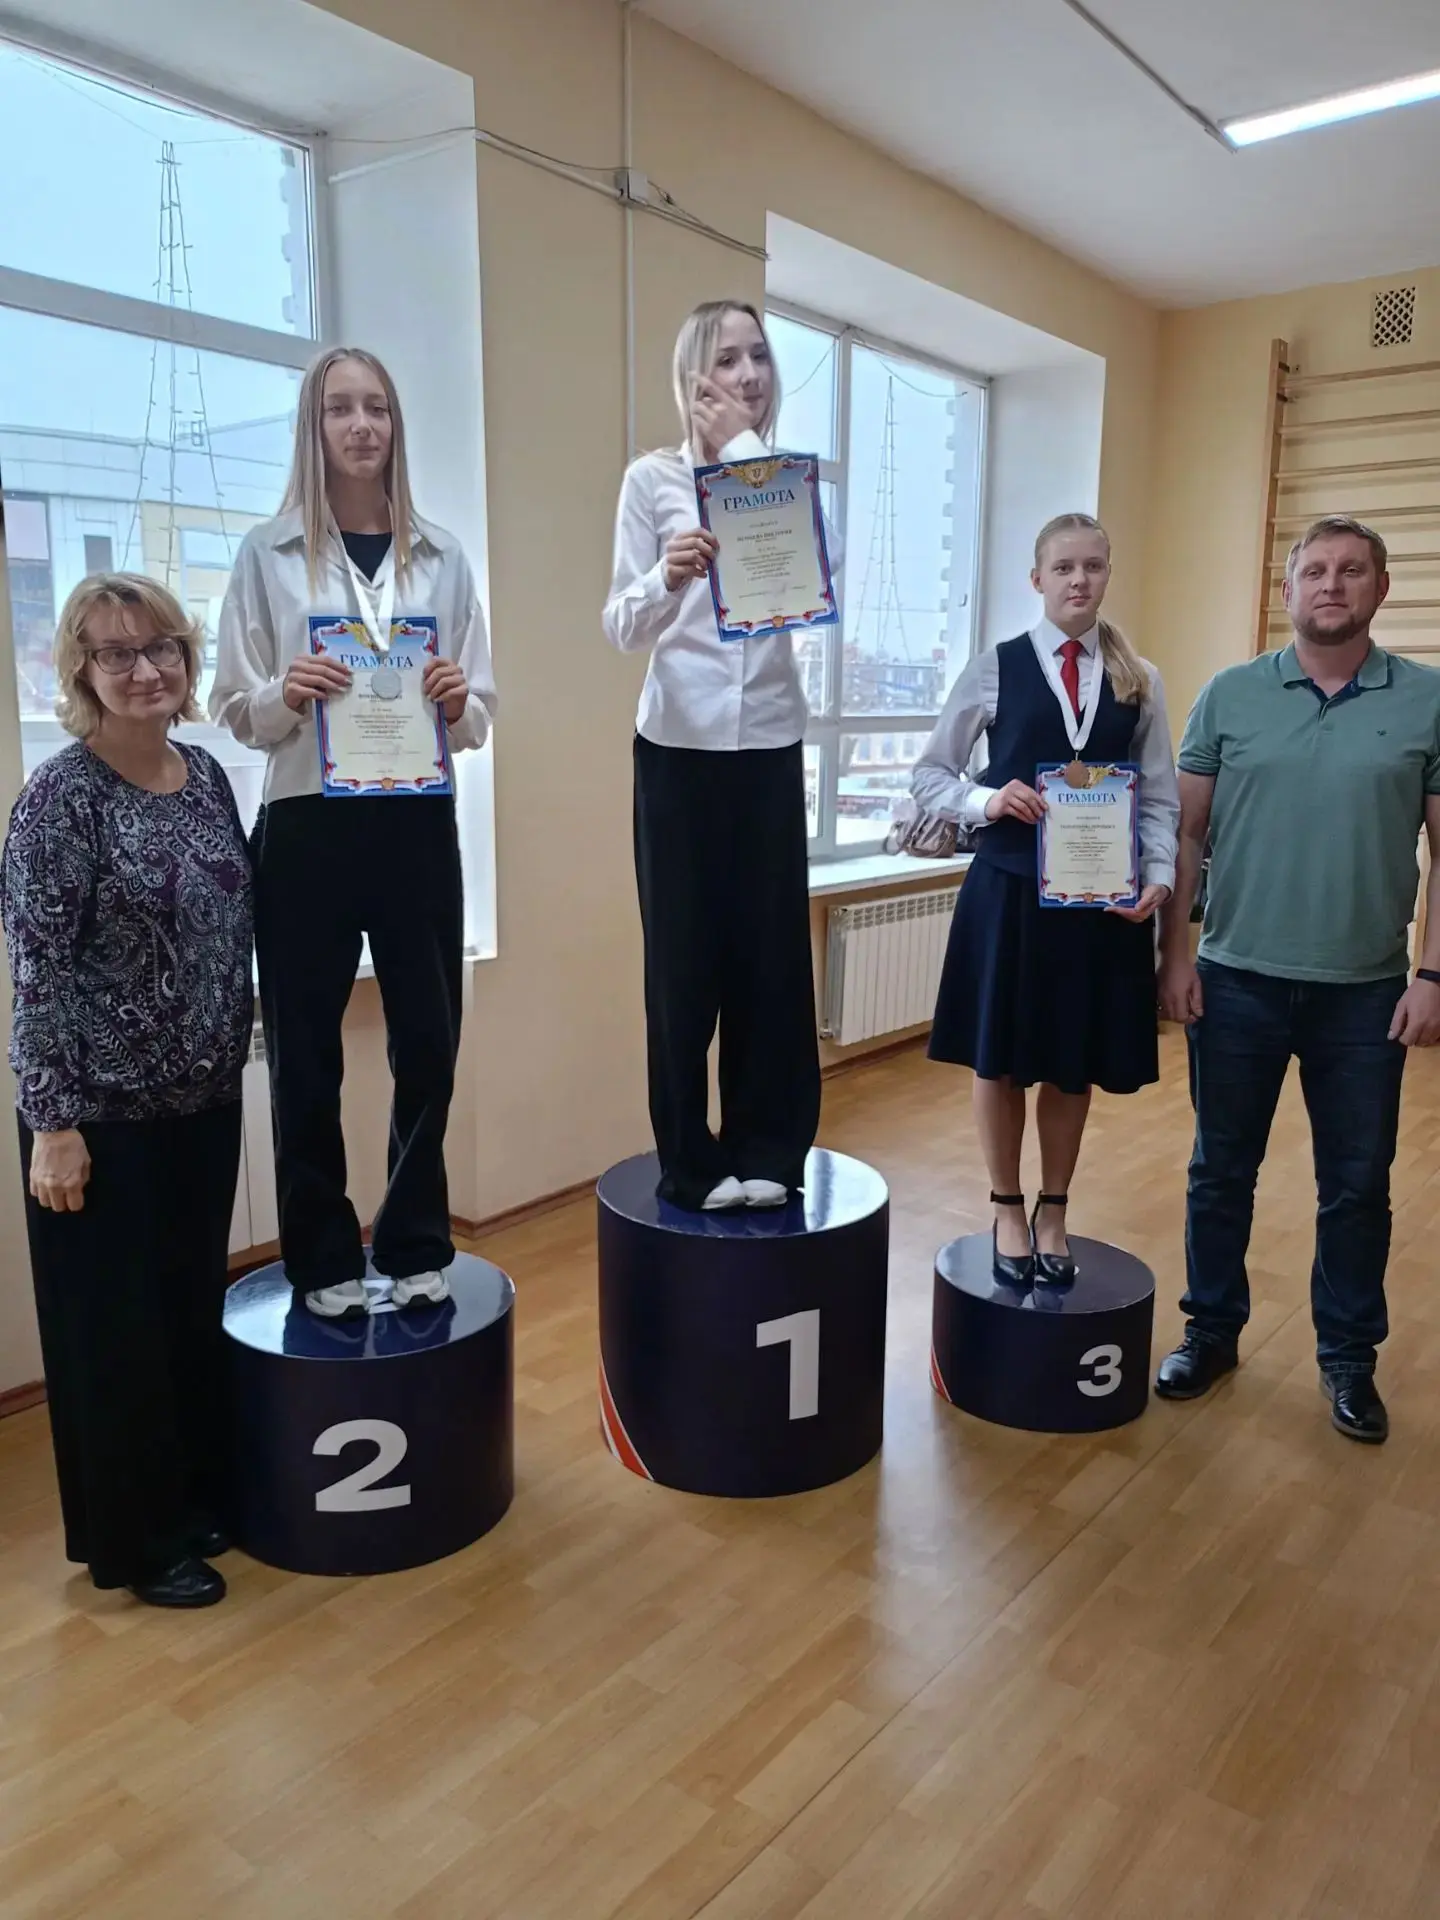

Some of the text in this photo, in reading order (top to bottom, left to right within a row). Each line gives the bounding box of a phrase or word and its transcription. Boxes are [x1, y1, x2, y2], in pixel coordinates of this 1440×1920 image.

[723, 489, 796, 511] ГРАМОТА
[340, 654, 413, 668] ГРАМОТА
[1058, 792, 1117, 803] ГРАМОТА
[756, 1309, 820, 1420] 1
[1076, 1344, 1122, 1397] 3
[312, 1419, 411, 1512] 2
